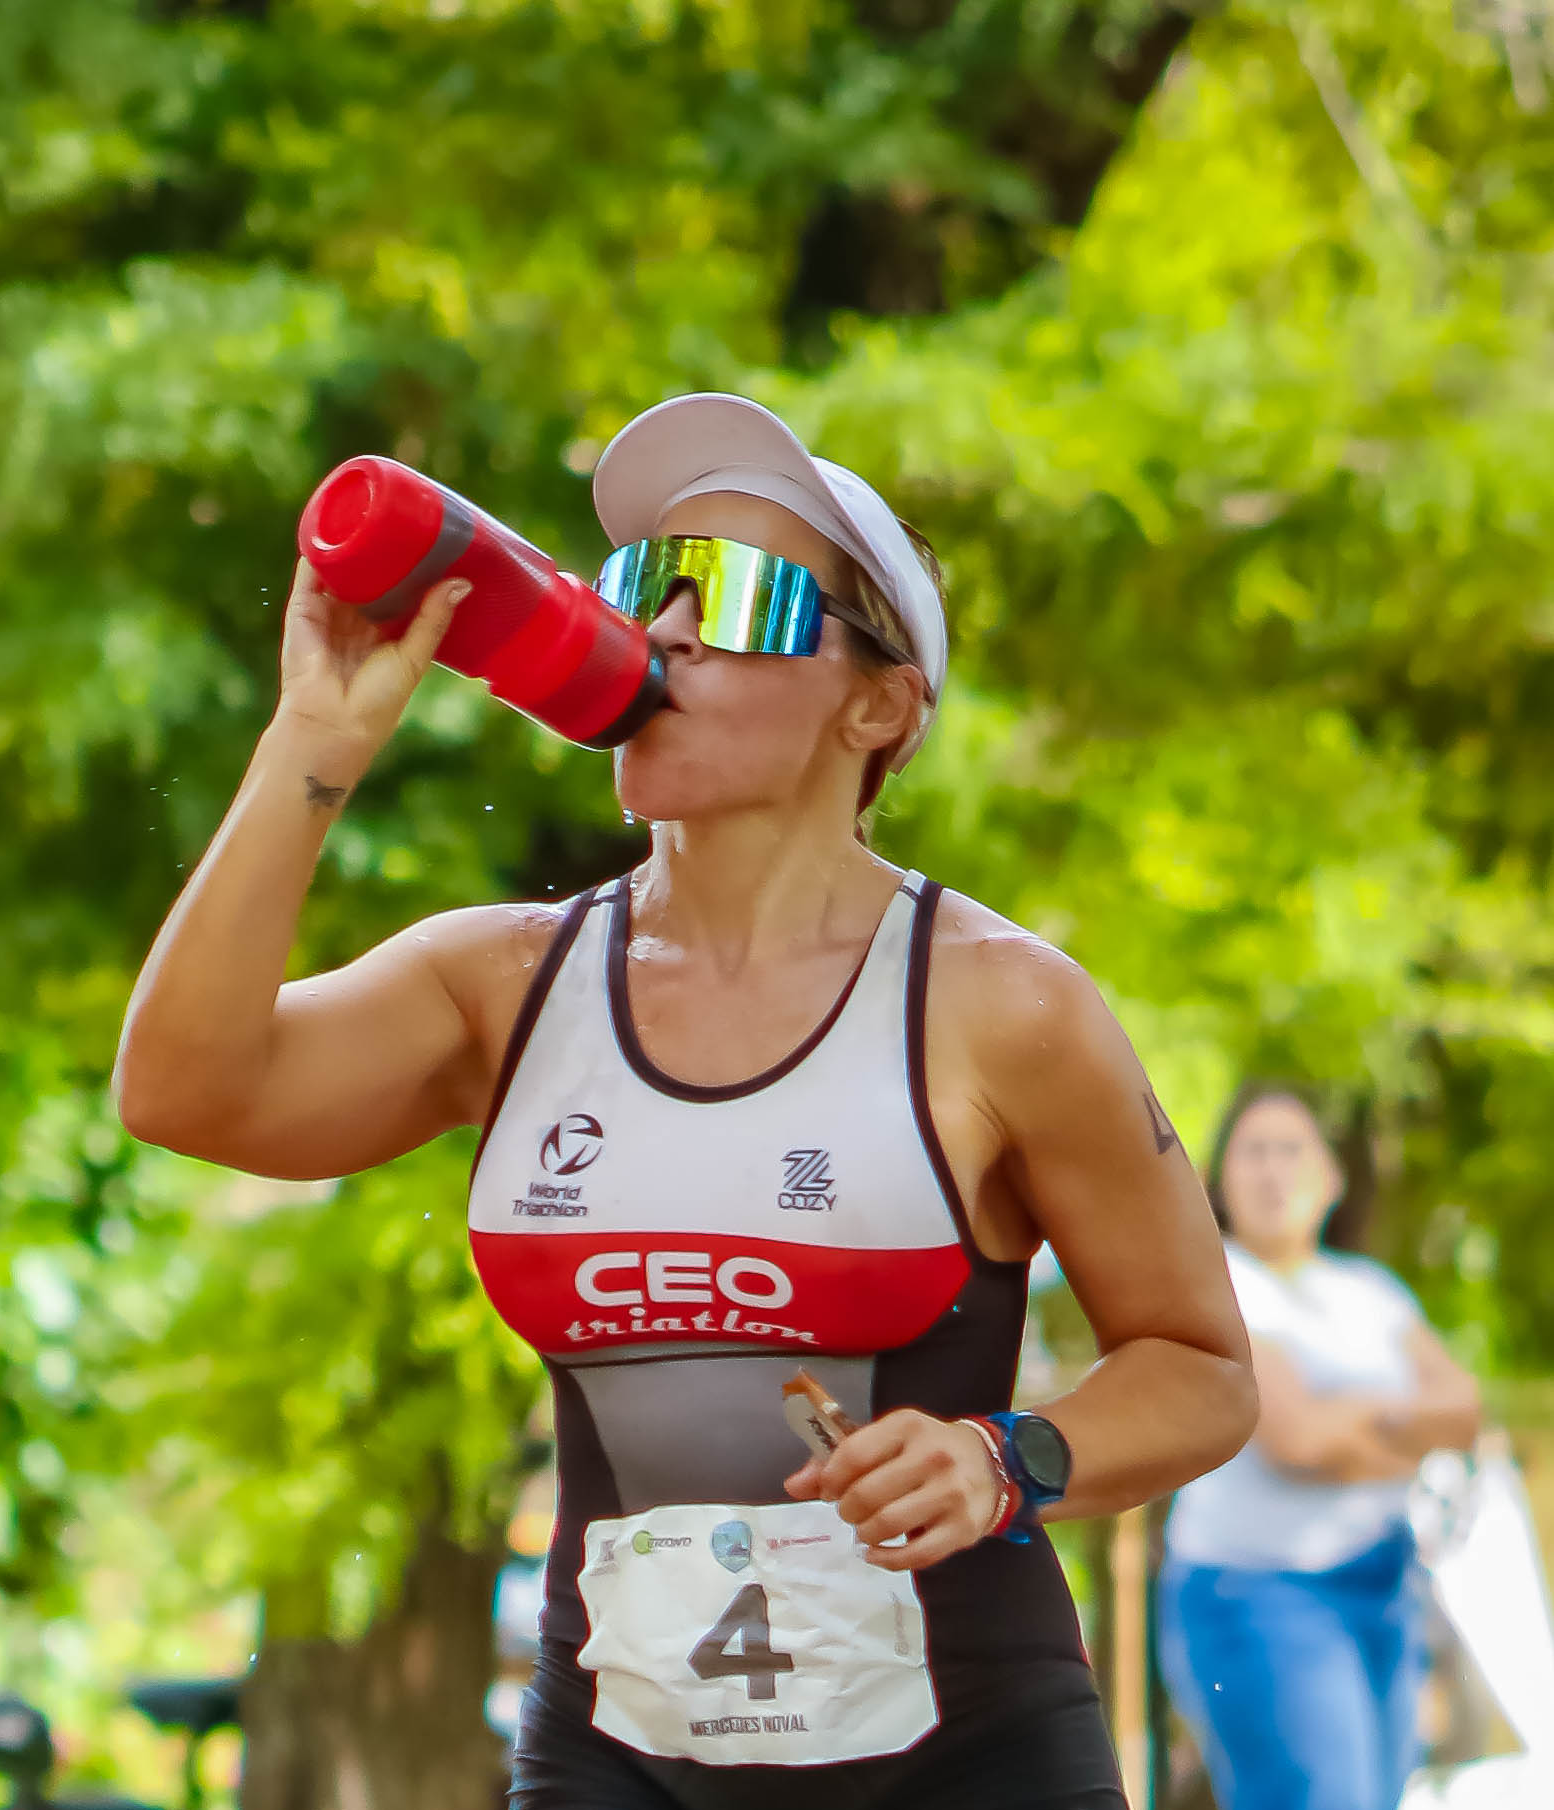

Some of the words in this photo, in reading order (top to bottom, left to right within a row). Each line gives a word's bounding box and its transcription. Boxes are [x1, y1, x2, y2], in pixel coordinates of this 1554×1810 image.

[527, 1182, 582, 1200] World
[778, 1193, 837, 1212] COZY
[512, 1199, 588, 1217] Triathlon
[574, 1251, 794, 1310] CEO
[565, 1306, 821, 1345] triatlon
[687, 1582, 794, 1700] 4
